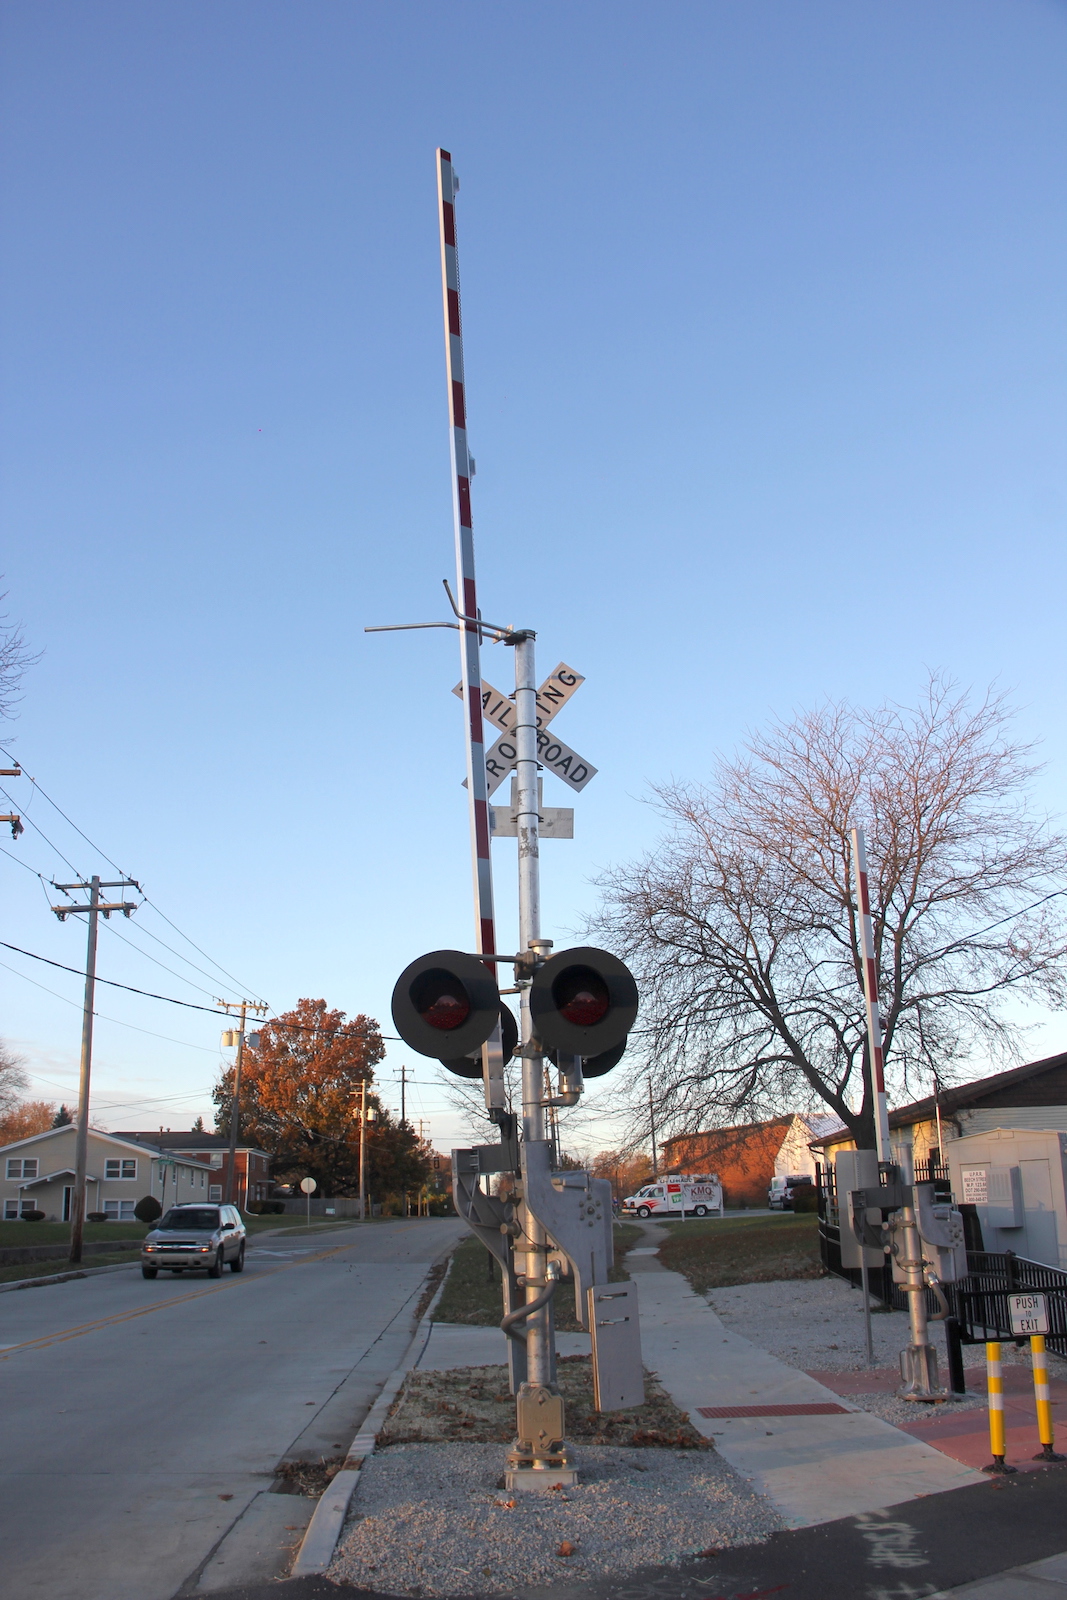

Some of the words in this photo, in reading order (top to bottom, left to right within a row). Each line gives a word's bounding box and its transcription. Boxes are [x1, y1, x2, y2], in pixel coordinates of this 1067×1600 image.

[536, 731, 588, 783] ROAD
[1016, 1298, 1038, 1308] PUSH
[1021, 1319, 1038, 1330] EXIT
